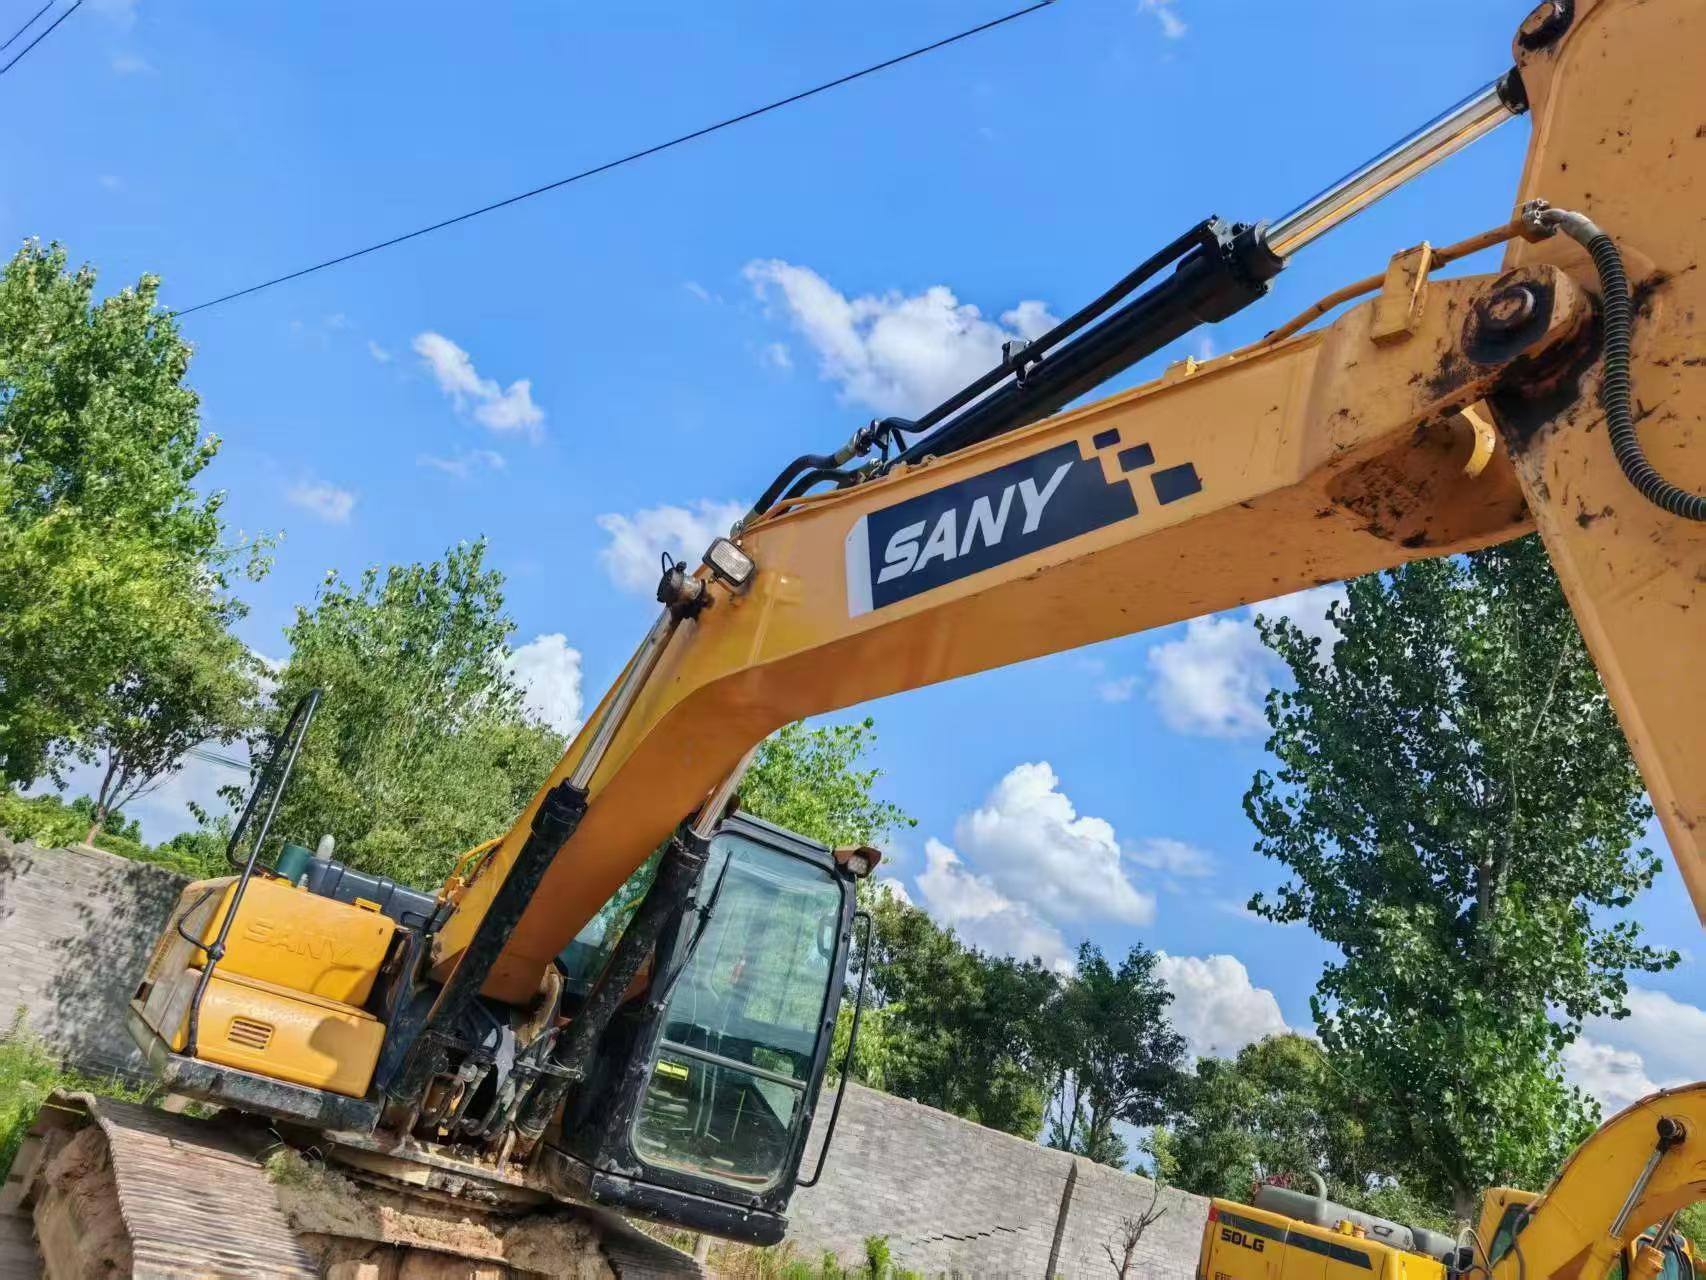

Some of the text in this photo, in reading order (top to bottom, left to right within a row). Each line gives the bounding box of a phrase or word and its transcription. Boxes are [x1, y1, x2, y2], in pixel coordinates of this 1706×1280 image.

[877, 461, 1074, 584] SANY
[243, 917, 354, 961] SANY
[1221, 1227, 1264, 1252] SDLG
